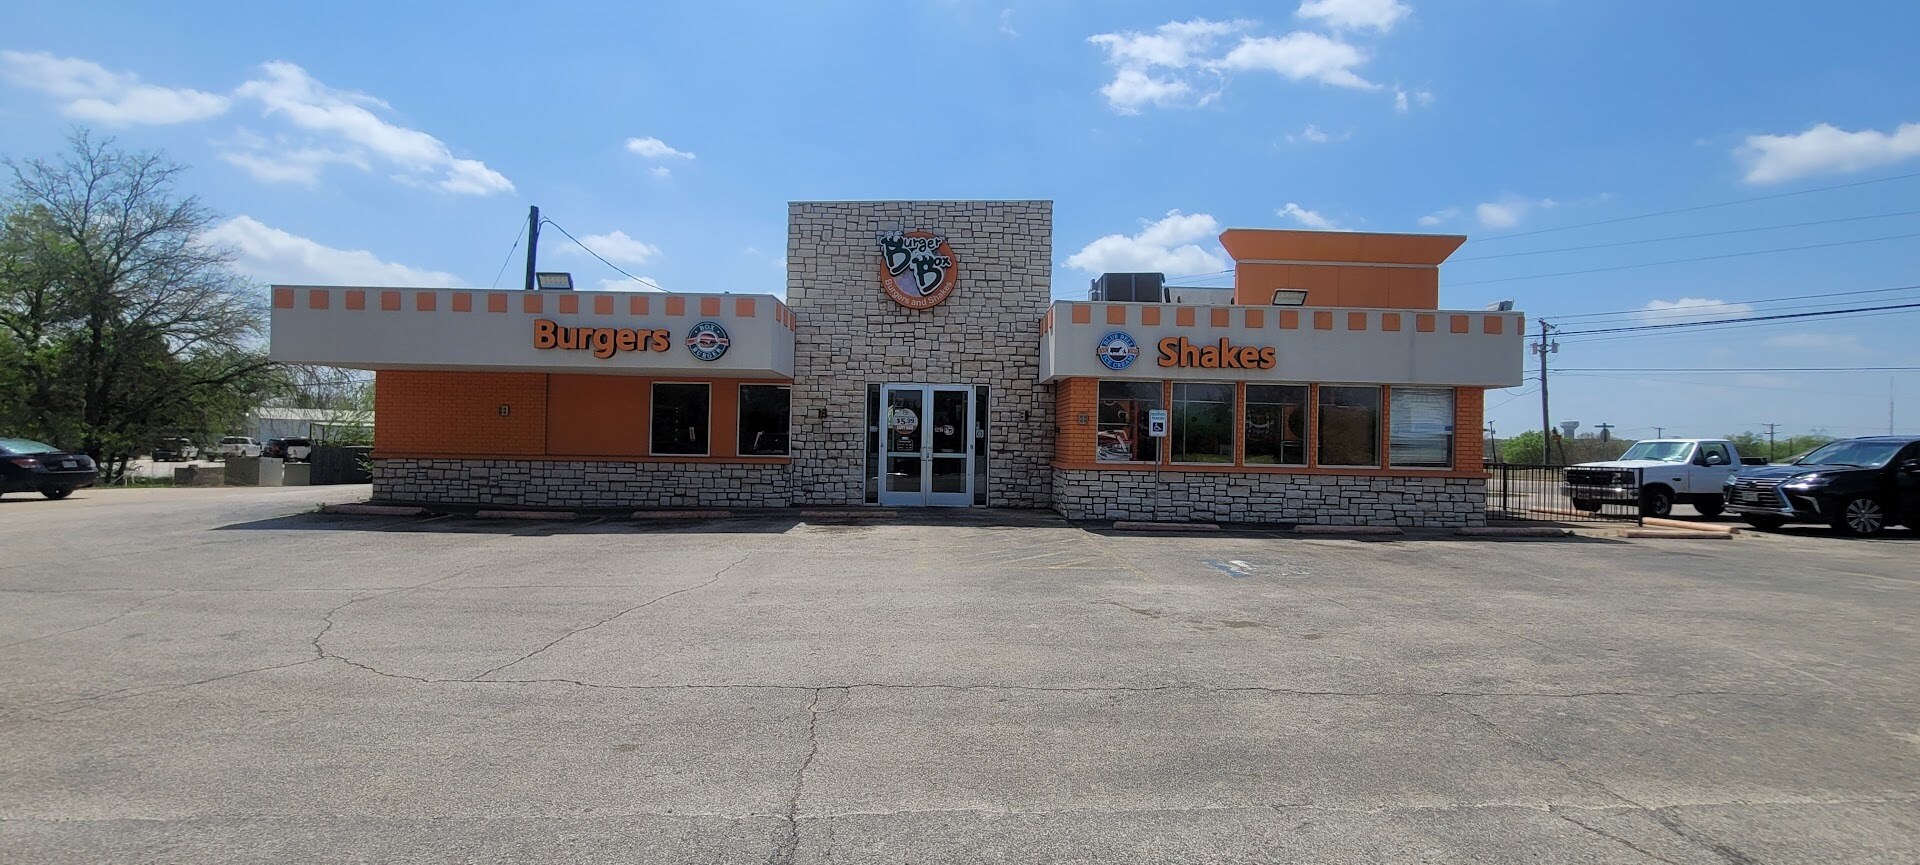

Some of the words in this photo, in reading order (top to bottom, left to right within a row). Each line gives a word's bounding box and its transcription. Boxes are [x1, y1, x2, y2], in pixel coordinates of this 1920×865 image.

[880, 234, 942, 276] Burger
[911, 254, 951, 295] Box
[885, 278, 910, 304] Burgers
[929, 282, 953, 304] Shakes
[534, 319, 670, 359] Burgers
[692, 346, 722, 359] BURGER
[1103, 333, 1119, 346] BLUE
[1119, 333, 1134, 347] BELL
[1157, 336, 1276, 369] Shakes
[1102, 354, 1113, 365] ICE
[1112, 355, 1134, 368] CREAM
